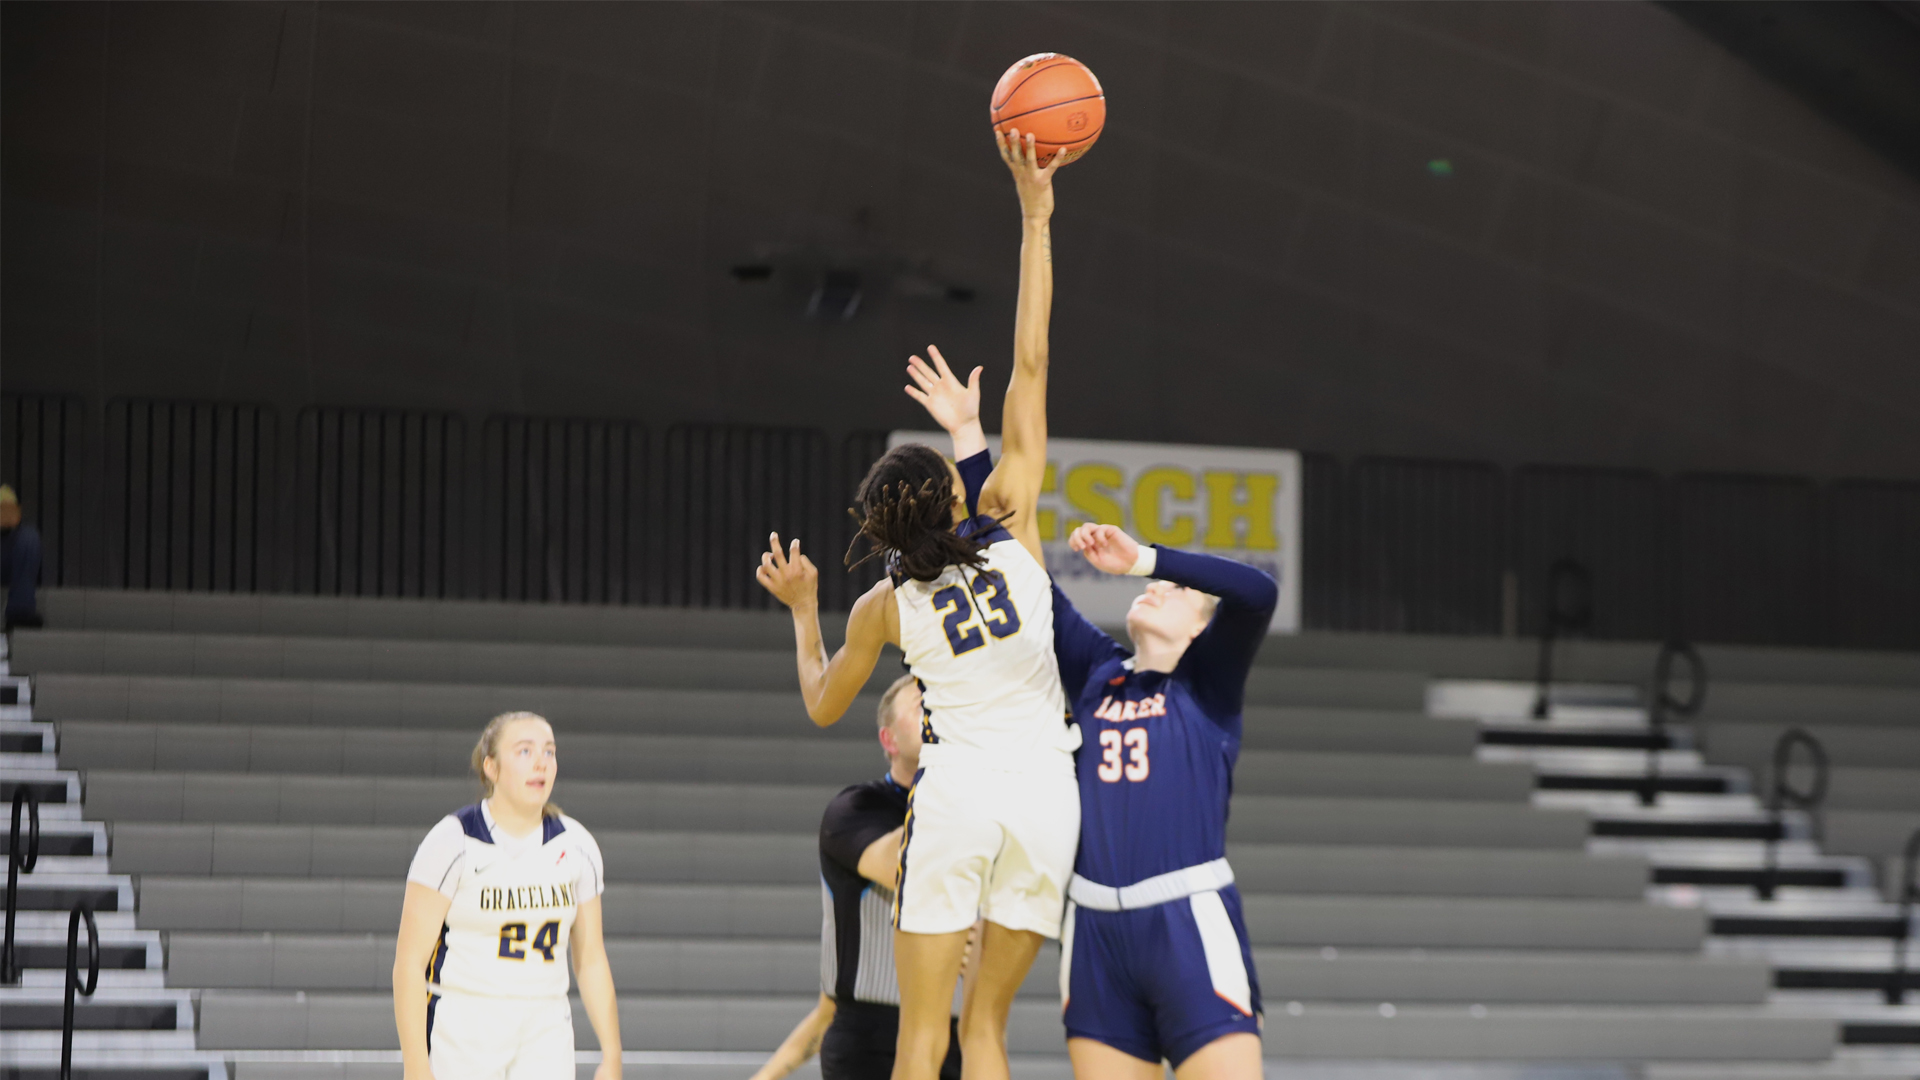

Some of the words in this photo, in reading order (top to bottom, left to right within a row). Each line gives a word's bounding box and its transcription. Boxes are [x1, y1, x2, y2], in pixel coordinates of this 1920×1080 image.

[930, 567, 1022, 658] 23
[1097, 727, 1150, 783] 33
[497, 918, 561, 963] 24
